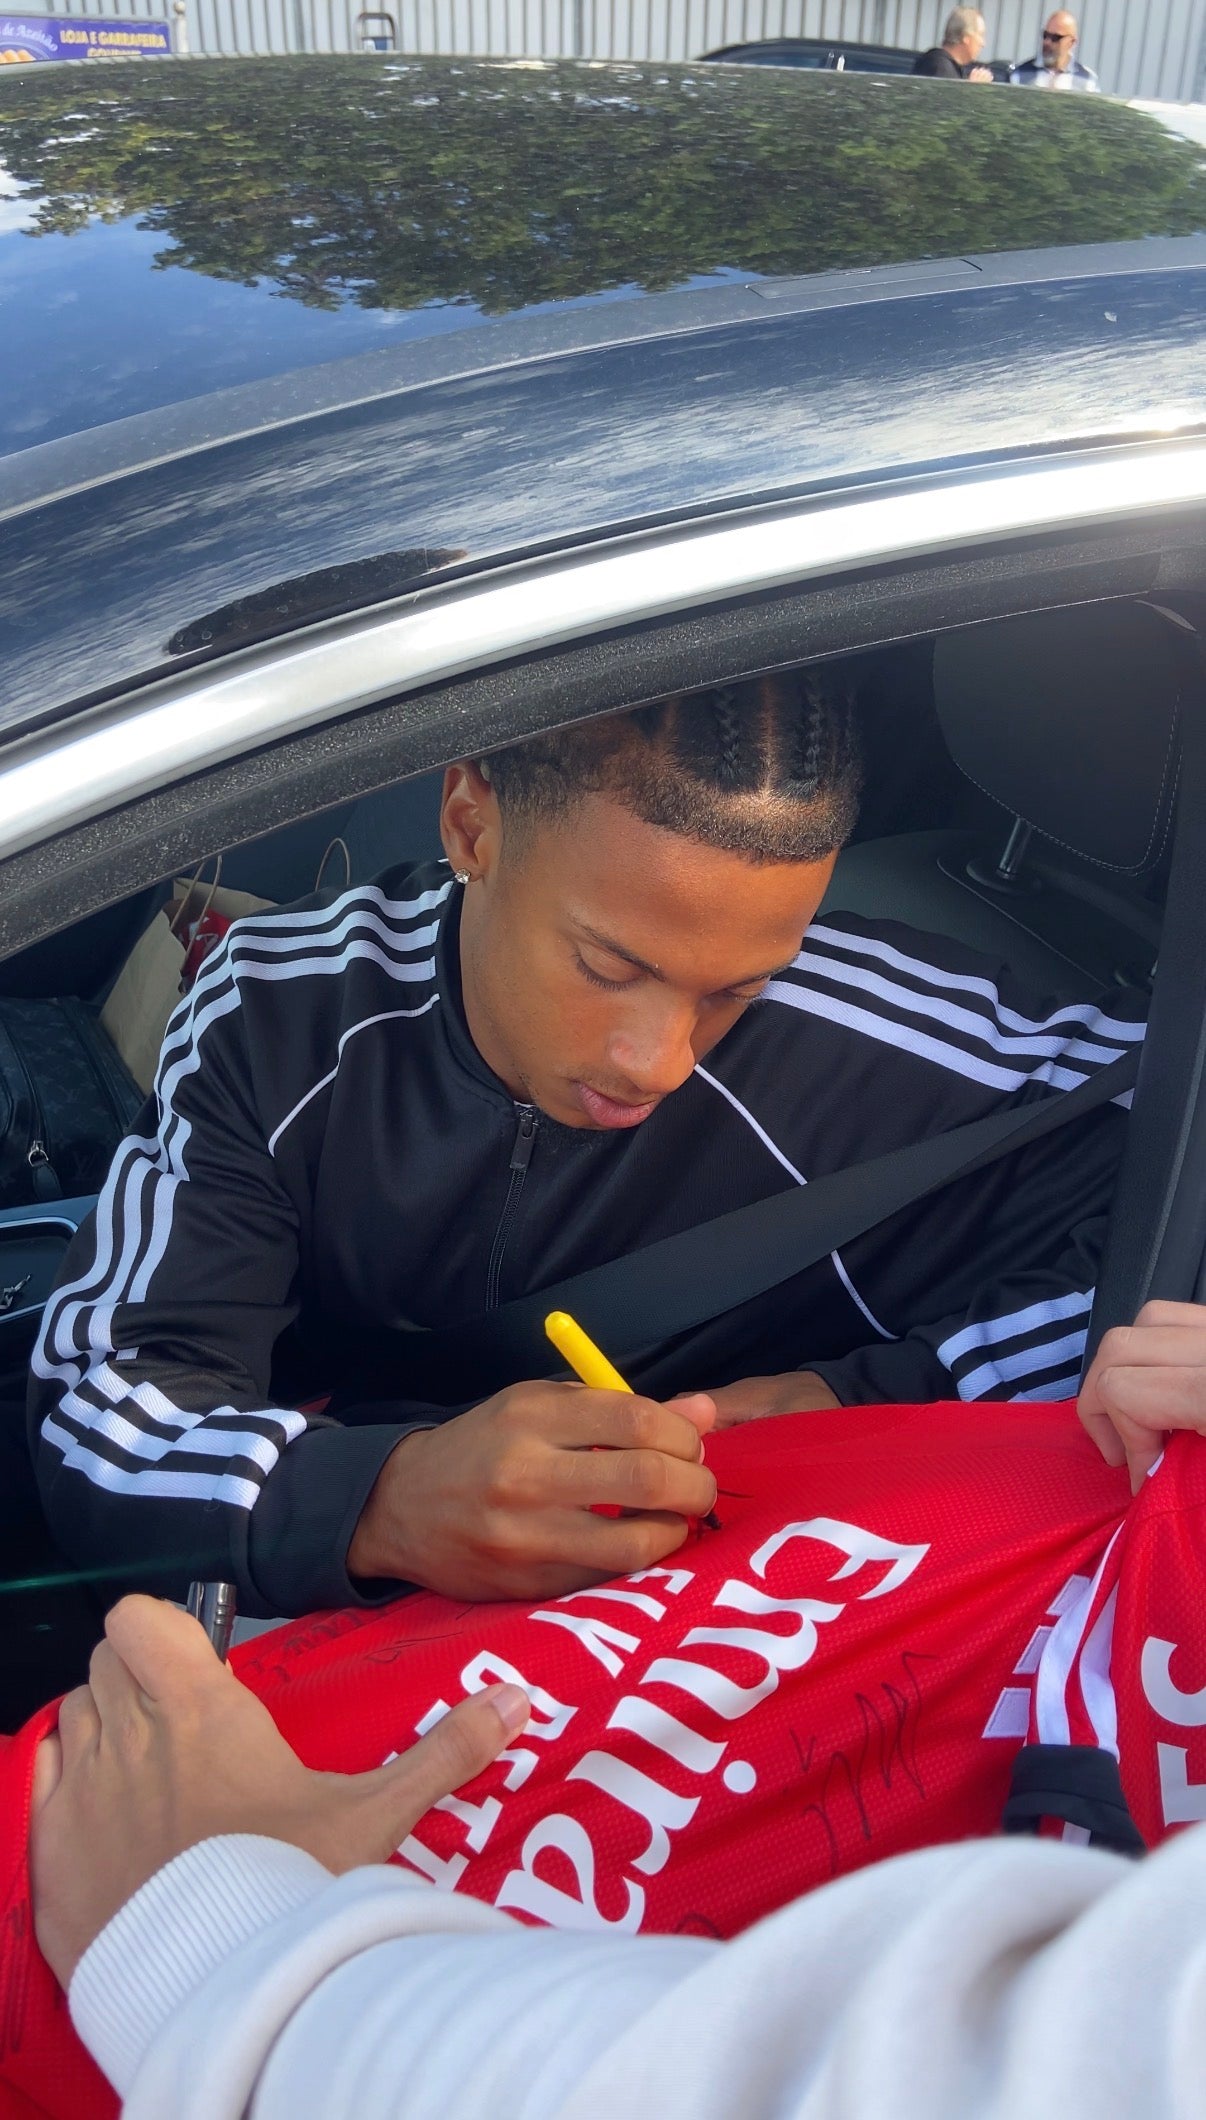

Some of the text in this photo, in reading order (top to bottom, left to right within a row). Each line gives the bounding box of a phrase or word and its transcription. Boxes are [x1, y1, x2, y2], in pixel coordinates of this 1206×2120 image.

[60, 29, 167, 49] LOJA E GARRAFEIRA
